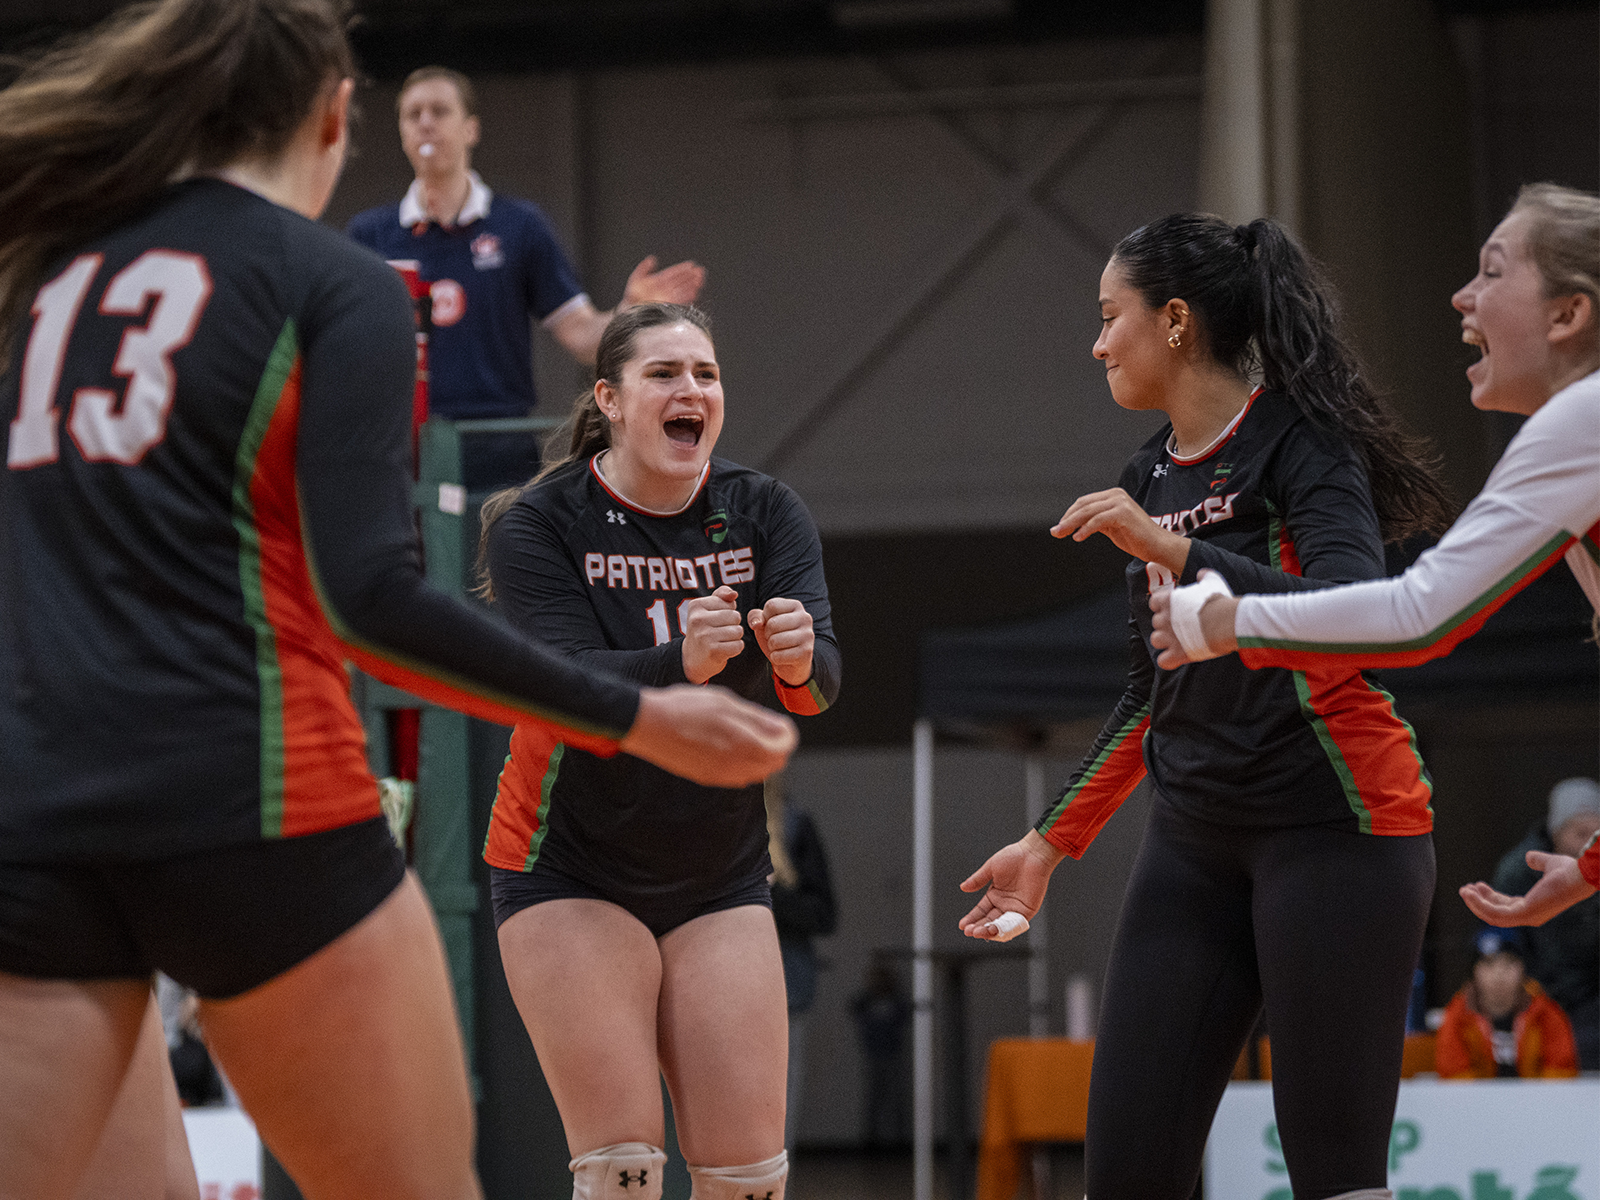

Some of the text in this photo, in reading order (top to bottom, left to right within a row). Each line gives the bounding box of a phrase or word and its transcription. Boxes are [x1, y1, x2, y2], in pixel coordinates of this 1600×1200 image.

[7, 248, 215, 470] 13
[585, 546, 755, 591] PATRIOTES
[645, 598, 690, 647] 1
